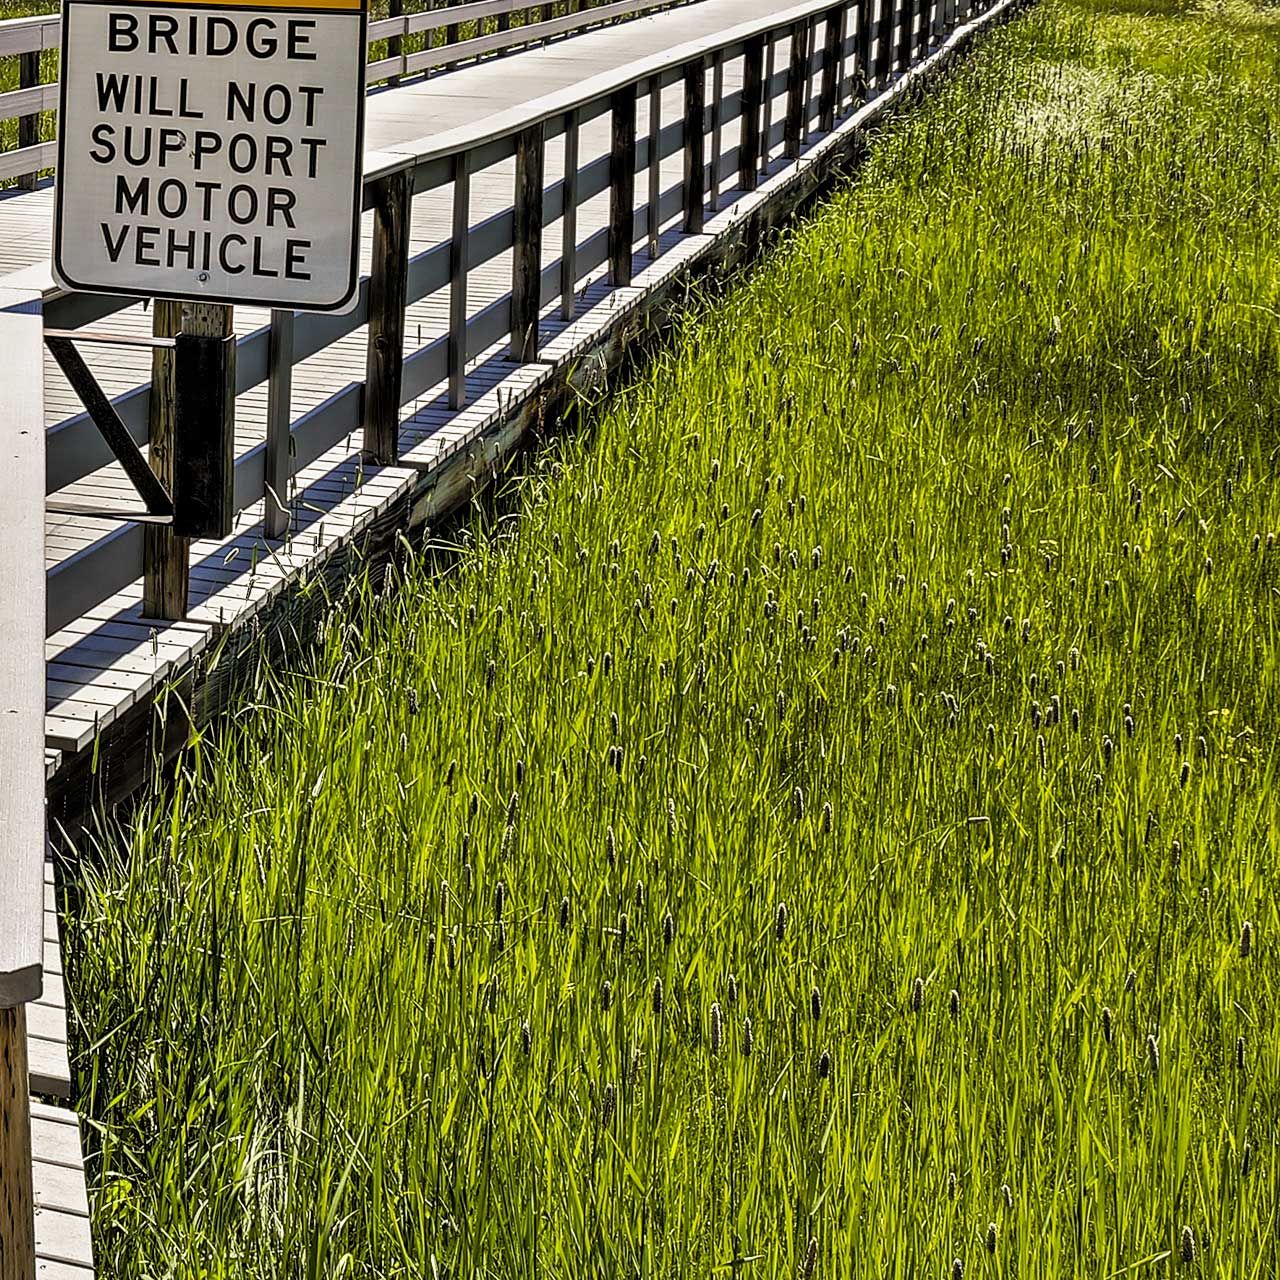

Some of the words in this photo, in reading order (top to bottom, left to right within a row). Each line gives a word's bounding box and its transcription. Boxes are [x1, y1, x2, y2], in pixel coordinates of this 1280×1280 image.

[108, 13, 317, 60] BRIDGE
[96, 73, 203, 118] WILL
[227, 81, 324, 126] NOT
[89, 123, 327, 178] SUPPORT
[115, 175, 296, 228] MOTOR
[101, 223, 312, 280] VEHICLE
